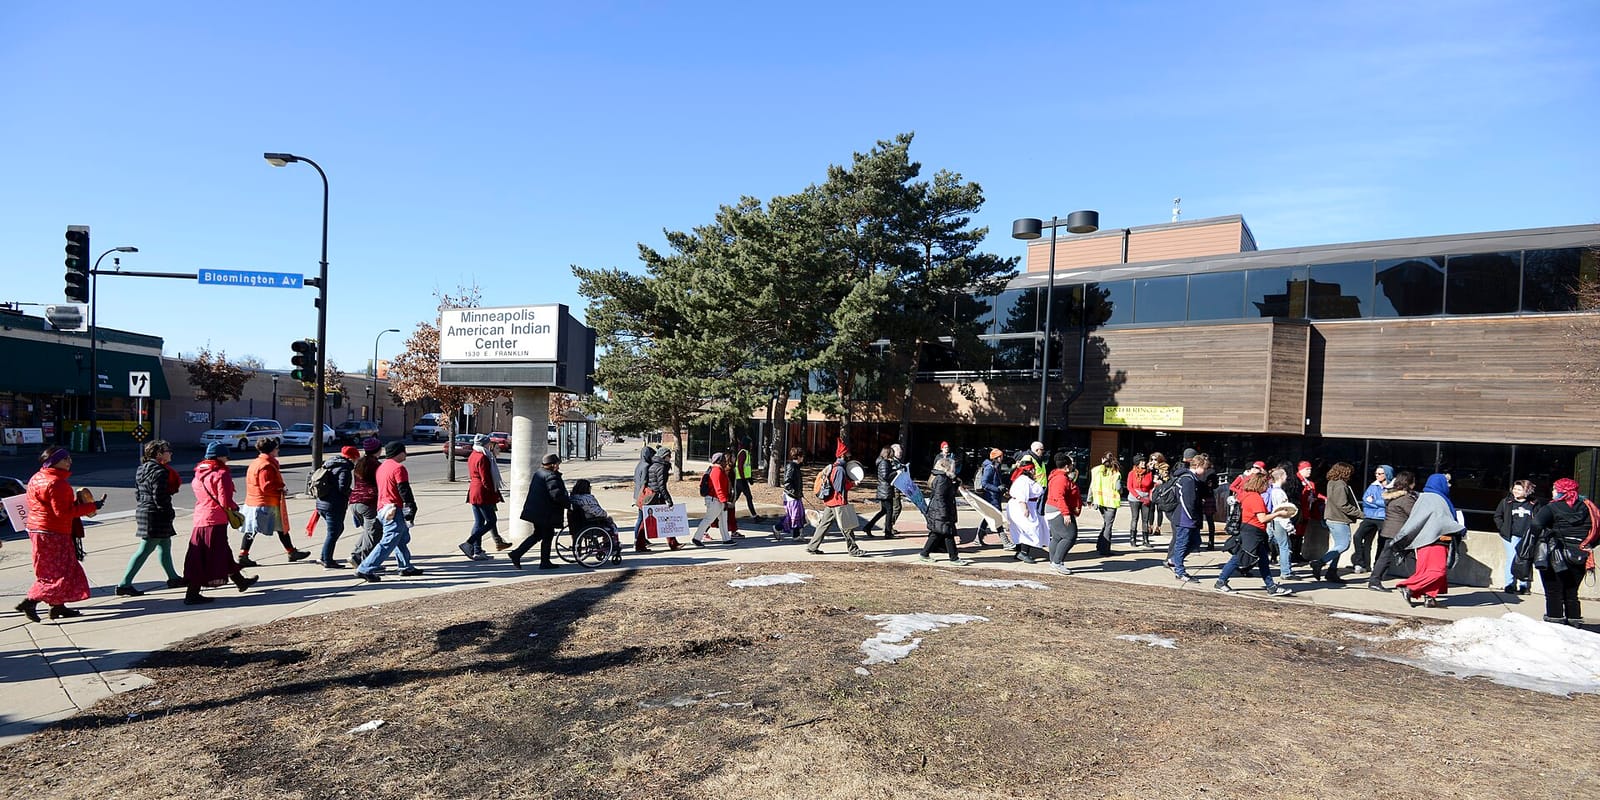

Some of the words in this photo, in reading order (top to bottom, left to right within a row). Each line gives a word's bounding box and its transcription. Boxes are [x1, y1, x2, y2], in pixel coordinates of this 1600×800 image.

[204, 272, 275, 286] Bloomington
[282, 276, 297, 285] Av
[460, 309, 535, 323] Minneapolis
[447, 325, 505, 337] American
[511, 323, 551, 335] Indian
[475, 337, 518, 350] Center
[16, 504, 28, 521] YOU
